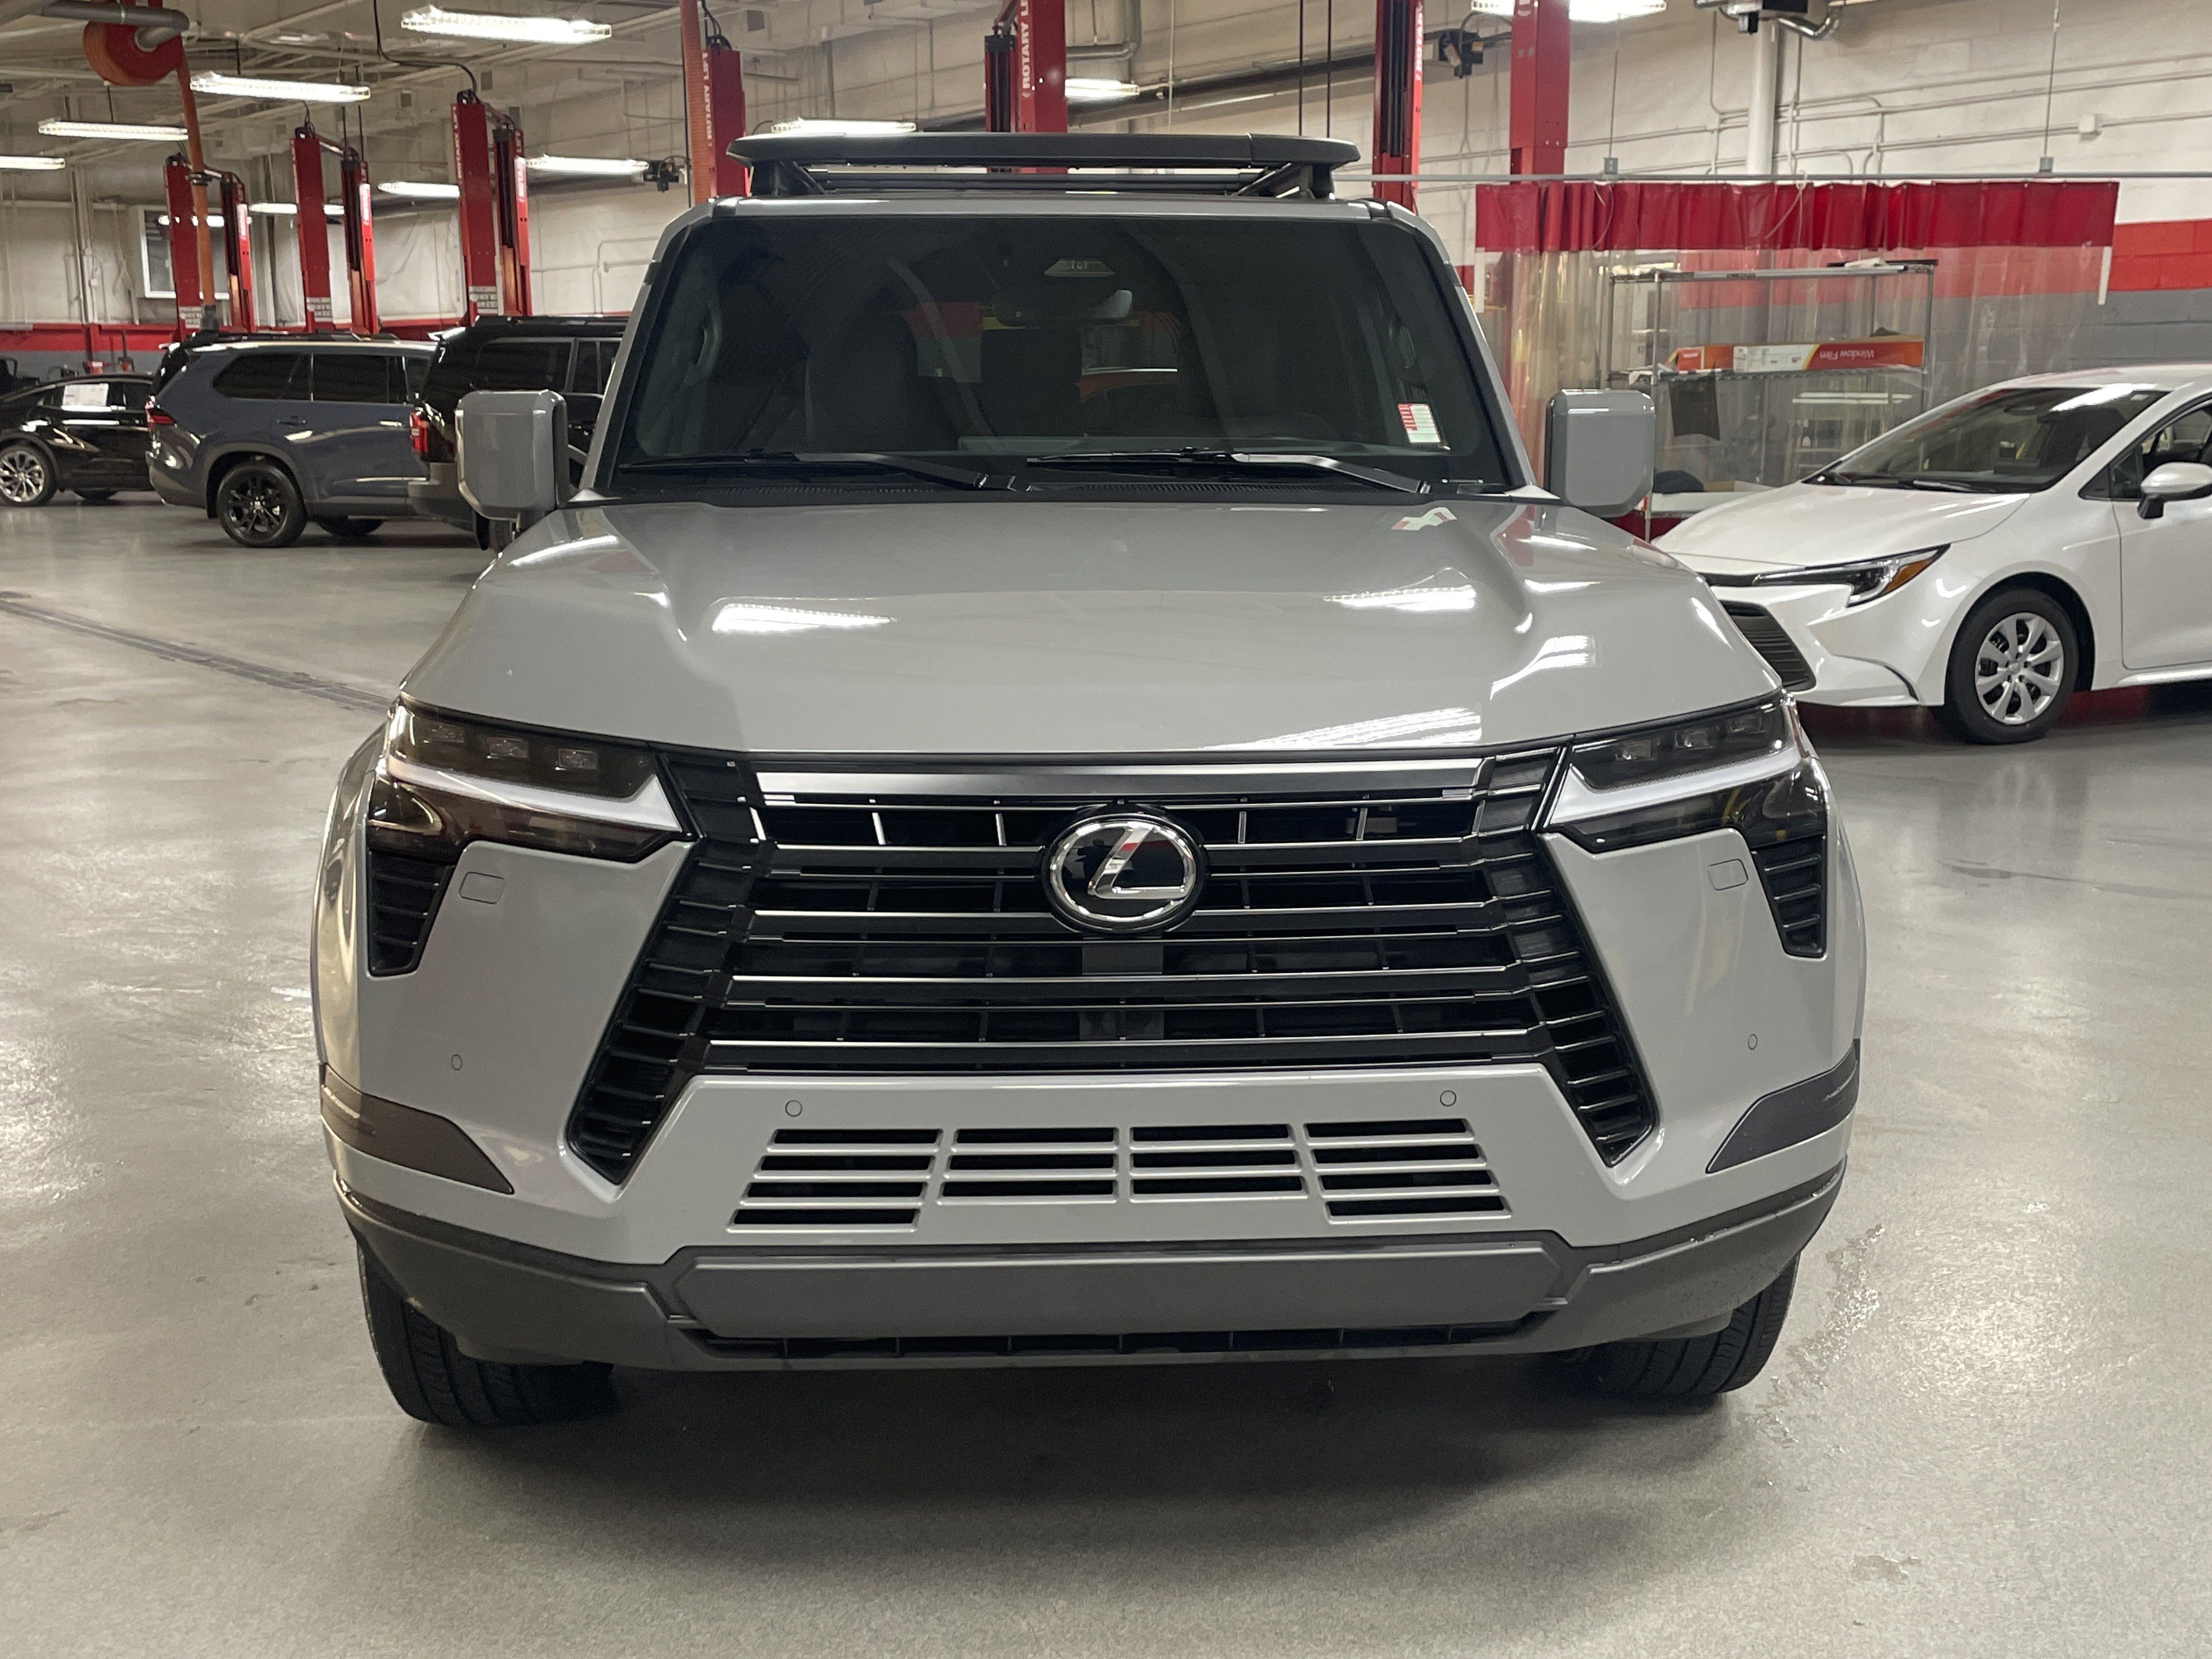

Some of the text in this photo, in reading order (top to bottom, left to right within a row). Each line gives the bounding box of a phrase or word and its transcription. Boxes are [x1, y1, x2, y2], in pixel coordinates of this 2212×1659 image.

[1021, 21, 1030, 89] ROTARY
[1820, 349, 1875, 360] Window Film
